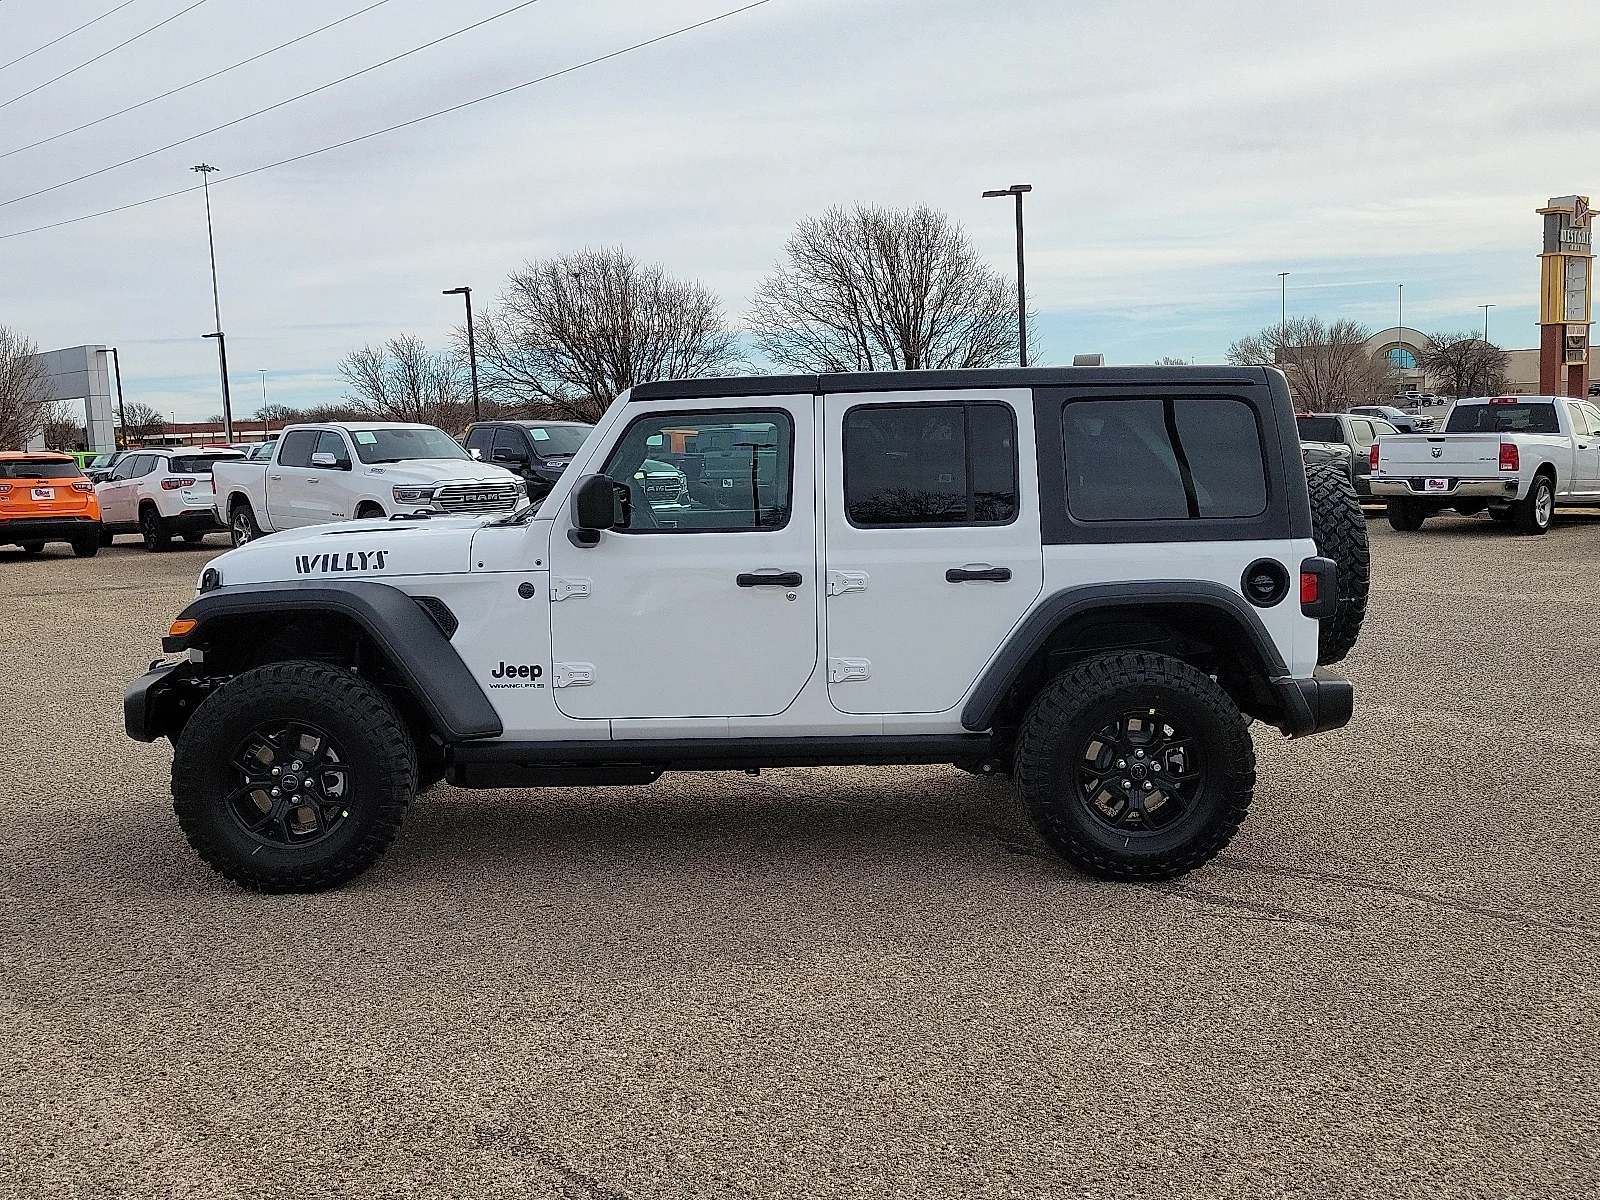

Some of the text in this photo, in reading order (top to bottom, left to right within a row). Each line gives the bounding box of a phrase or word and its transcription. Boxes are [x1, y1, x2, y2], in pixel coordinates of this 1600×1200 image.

[465, 493, 498, 501] RAM
[295, 550, 389, 574] WILLYS
[491, 661, 543, 681] Jeep
